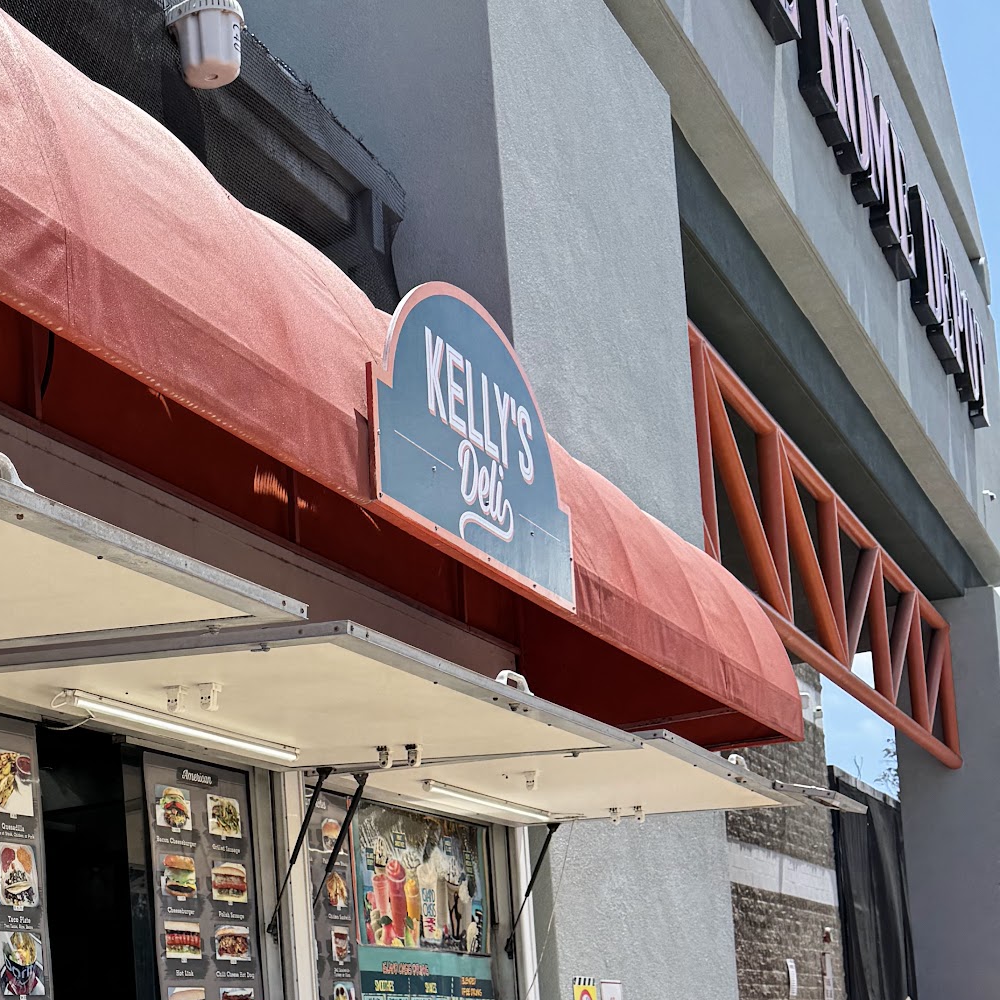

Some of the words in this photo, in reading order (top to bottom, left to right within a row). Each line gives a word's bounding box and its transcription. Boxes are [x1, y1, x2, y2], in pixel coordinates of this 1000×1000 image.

[915, 185, 990, 428] DEPOT
[425, 326, 534, 485] KELLY'S
[458, 439, 513, 543] Deli
[181, 769, 212, 785] American
